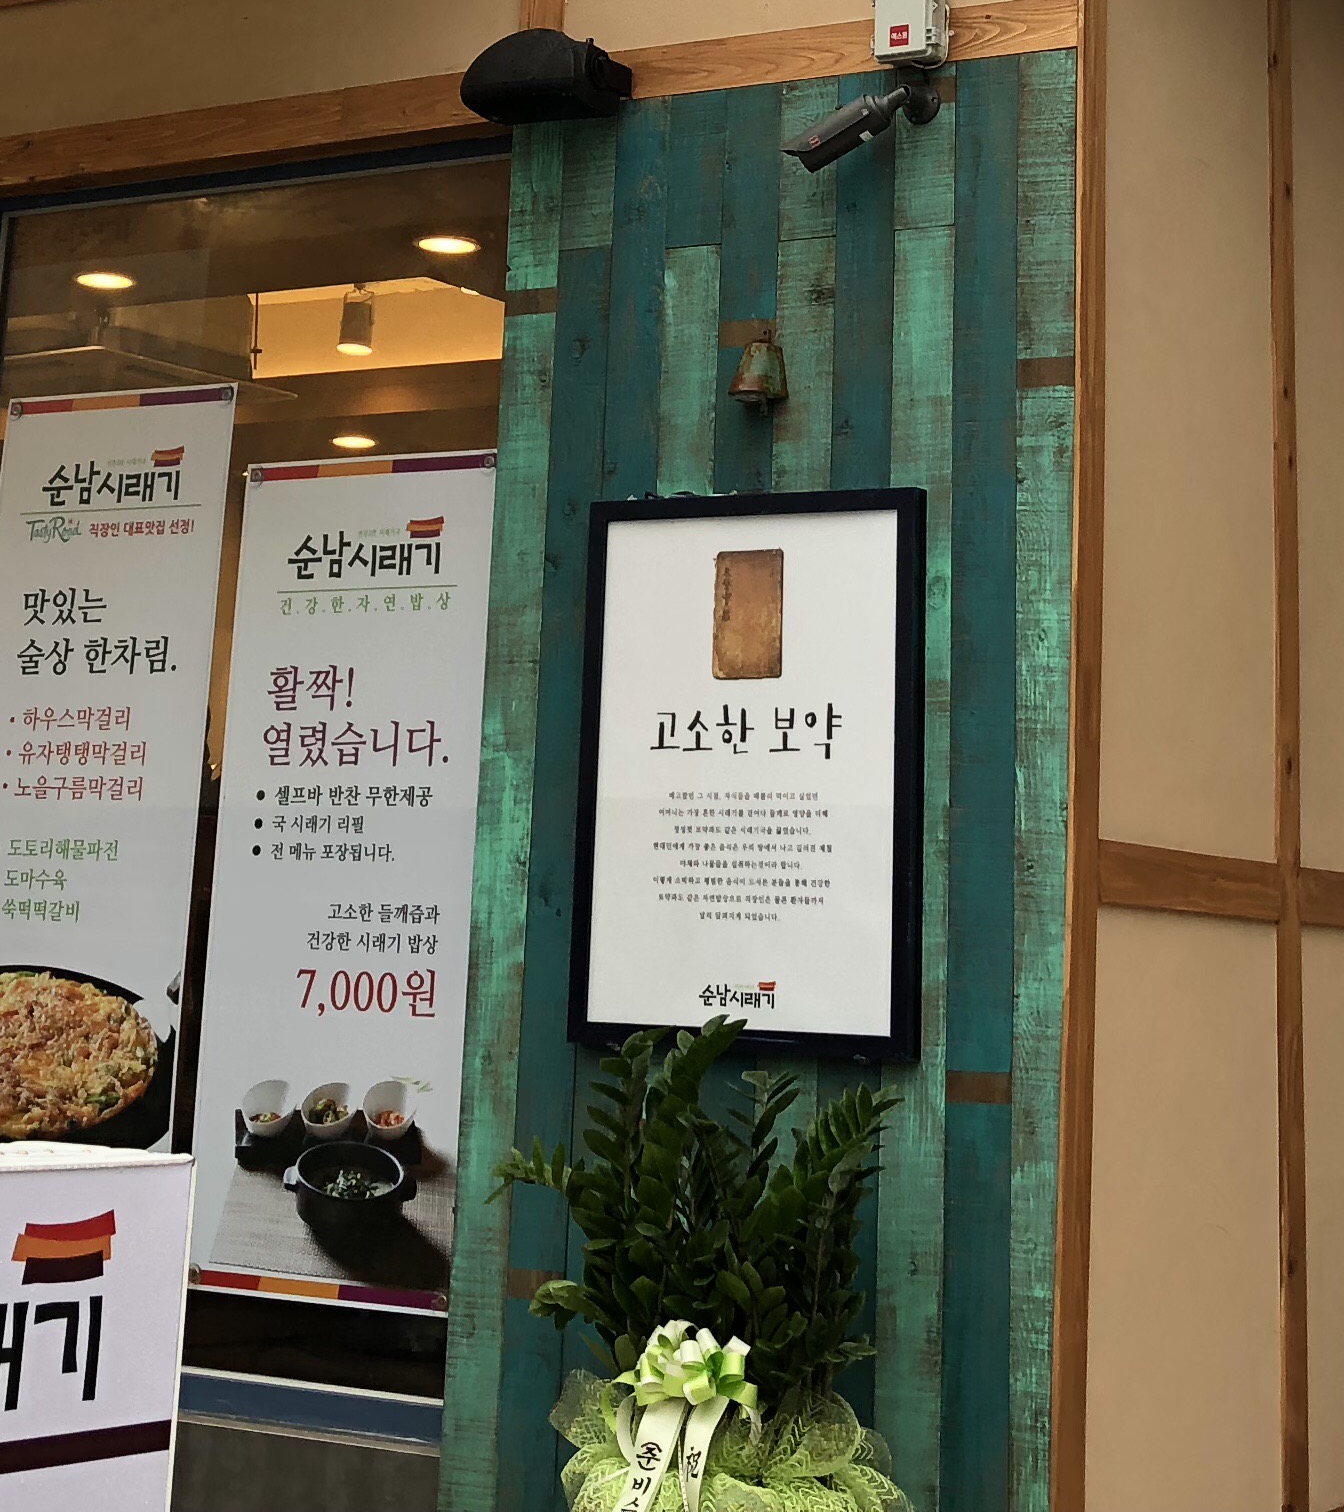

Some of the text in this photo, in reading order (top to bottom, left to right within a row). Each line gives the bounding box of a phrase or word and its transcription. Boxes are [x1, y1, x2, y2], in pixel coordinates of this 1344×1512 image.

[42, 461, 181, 507] 순남시래기
[89, 522, 120, 538] 직장인
[123, 520, 166, 536] 대표맛집
[288, 531, 441, 580] 순남시래기
[23, 587, 107, 627] 맛있는
[17, 636, 177, 676] 술상 한차림.
[267, 664, 354, 711] 활짝!
[23, 706, 131, 731] 하우스막걸리
[650, 702, 843, 760] 고소한 보약
[18, 740, 147, 766] 유자탱탱막걸리
[263, 720, 449, 767] 열렸습니다.
[14, 775, 144, 801] 노을구름막걸리
[275, 785, 433, 808] 셀프바 반찬 무한제공
[272, 815, 364, 834] 국 시래기 리필
[7, 838, 119, 861] 도토리해물파전
[271, 843, 395, 863] 전 메뉴 포장됩니다.
[4, 869, 67, 891] 도마수육
[328, 903, 373, 923] 고소한
[306, 931, 438, 955] 건강한 시래기 밥상
[296, 968, 436, 1018] 7,000원
[699, 984, 775, 1009] 순남시래기
